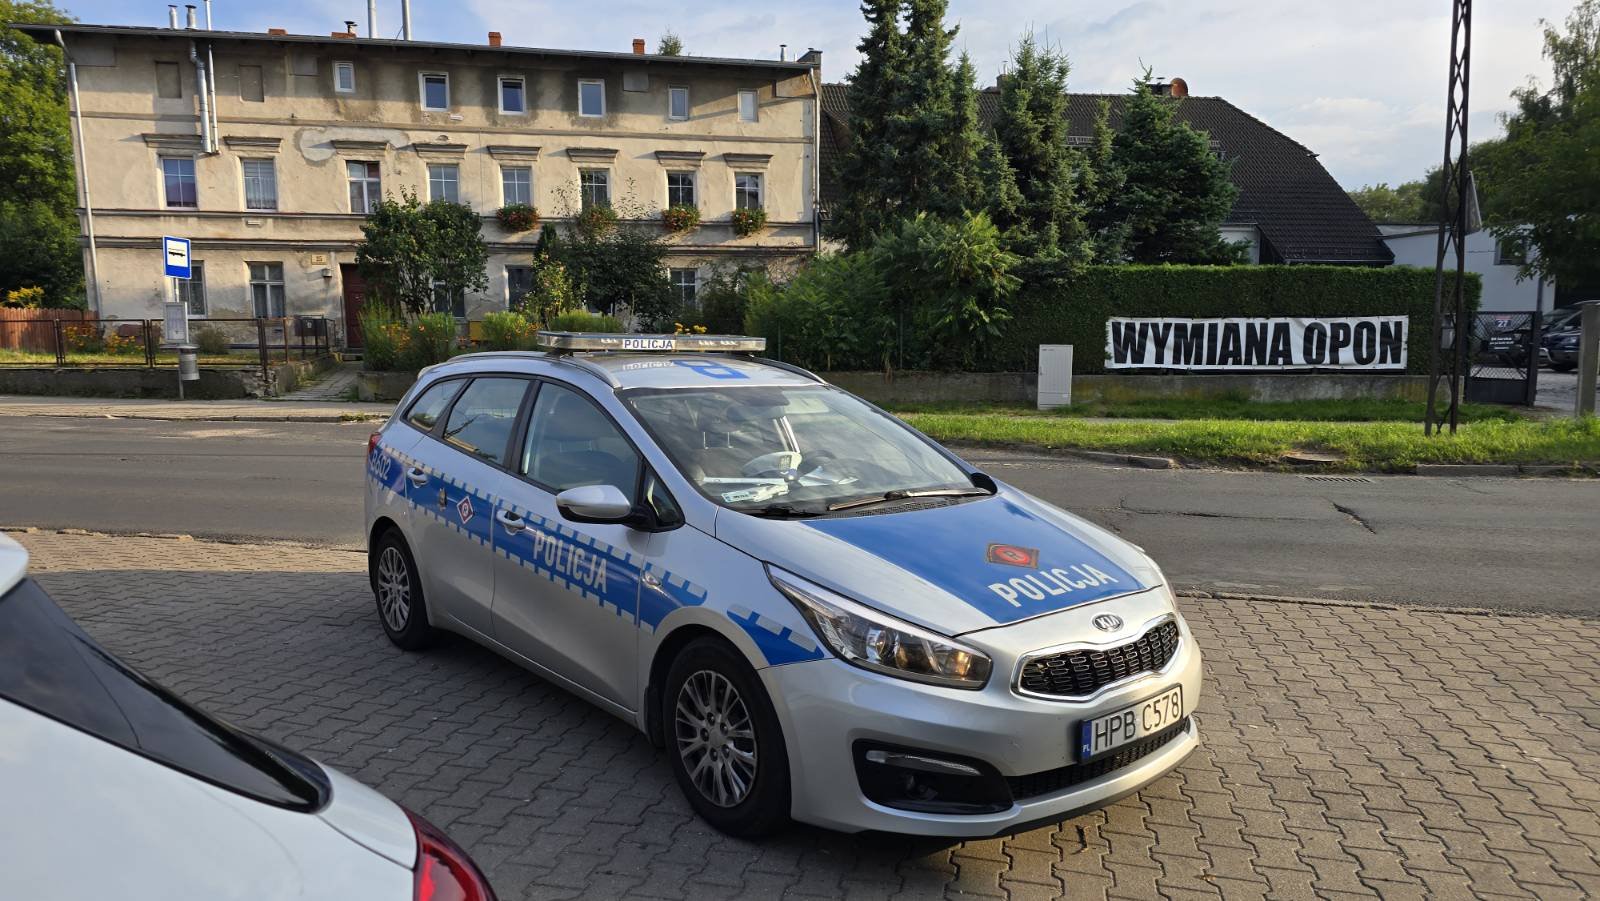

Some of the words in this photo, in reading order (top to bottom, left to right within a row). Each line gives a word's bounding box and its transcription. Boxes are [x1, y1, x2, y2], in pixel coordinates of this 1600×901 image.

[624, 339, 674, 350] POLICJA
[1111, 321, 1293, 366] WYMIANA
[1302, 320, 1403, 366] OPON
[532, 529, 608, 594] POLICJA
[988, 563, 1119, 608] POLICJA
[1095, 615, 1121, 629] KIA
[1094, 709, 1136, 751] HPB
[1141, 691, 1180, 732] C578
[1082, 744, 1090, 752] PL
